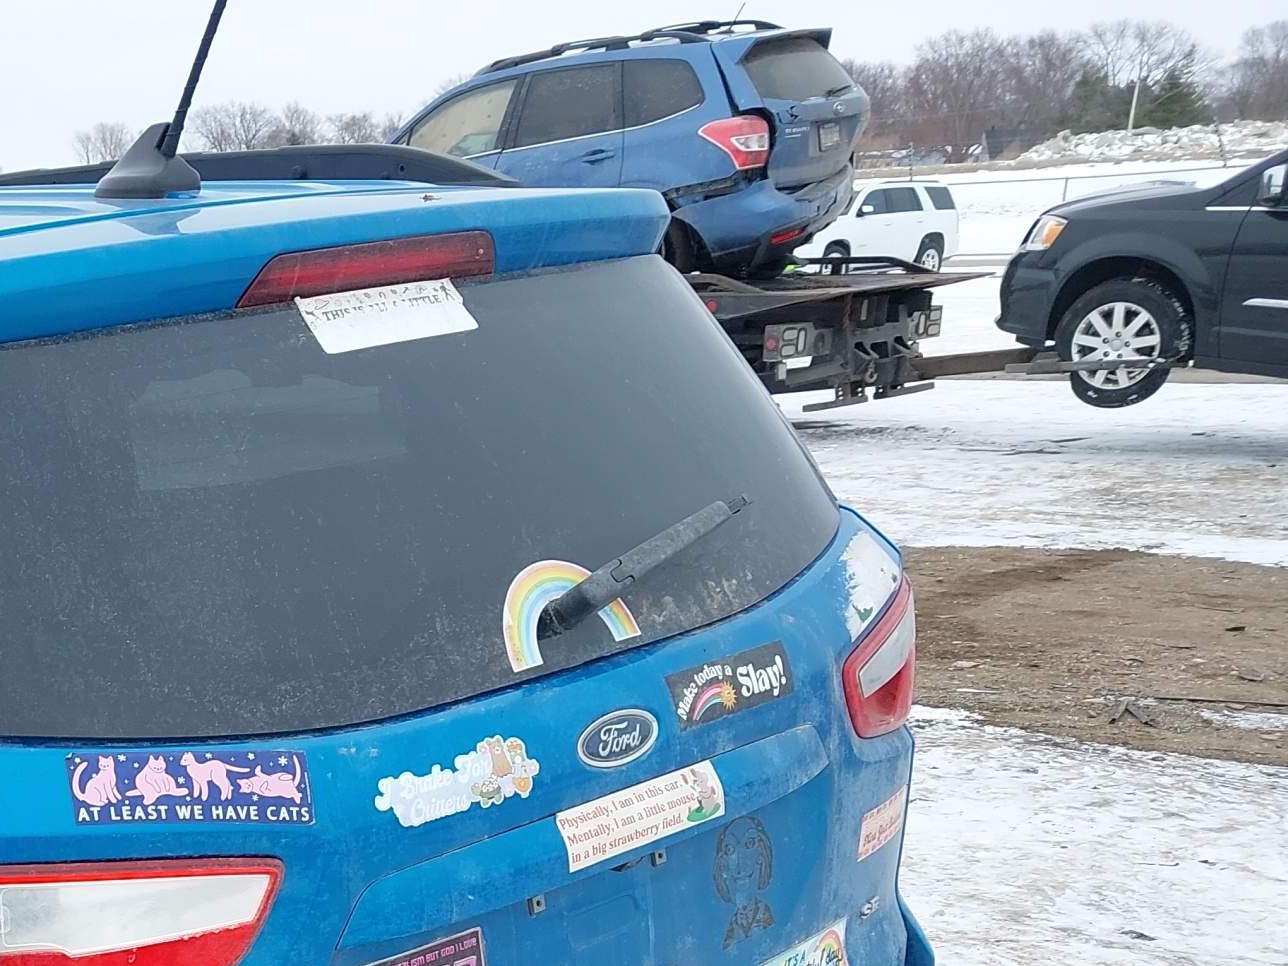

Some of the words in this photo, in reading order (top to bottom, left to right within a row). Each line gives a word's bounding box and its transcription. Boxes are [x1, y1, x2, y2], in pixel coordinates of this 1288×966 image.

[677, 682, 698, 720] Make
[693, 663, 725, 687] today
[724, 663, 733, 677] a
[736, 654, 787, 697] Slay!
[598, 721, 643, 757] Ford
[78, 806, 102, 822] AT
[110, 805, 168, 822] LEAST
[175, 804, 204, 820] WE
[212, 805, 260, 821] HAVE
[266, 805, 310, 822] CATS
[619, 798, 633, 810] am
[632, 792, 645, 806] in
[646, 785, 663, 802] this
[621, 814, 636, 827] am
[637, 812, 644, 822] a
[644, 803, 666, 819] little
[668, 792, 696, 811] mouse
[571, 851, 581, 864] in
[583, 849, 590, 860] a
[591, 841, 607, 857] big
[608, 821, 662, 851] strawberry
[800, 949, 806, 964] A
